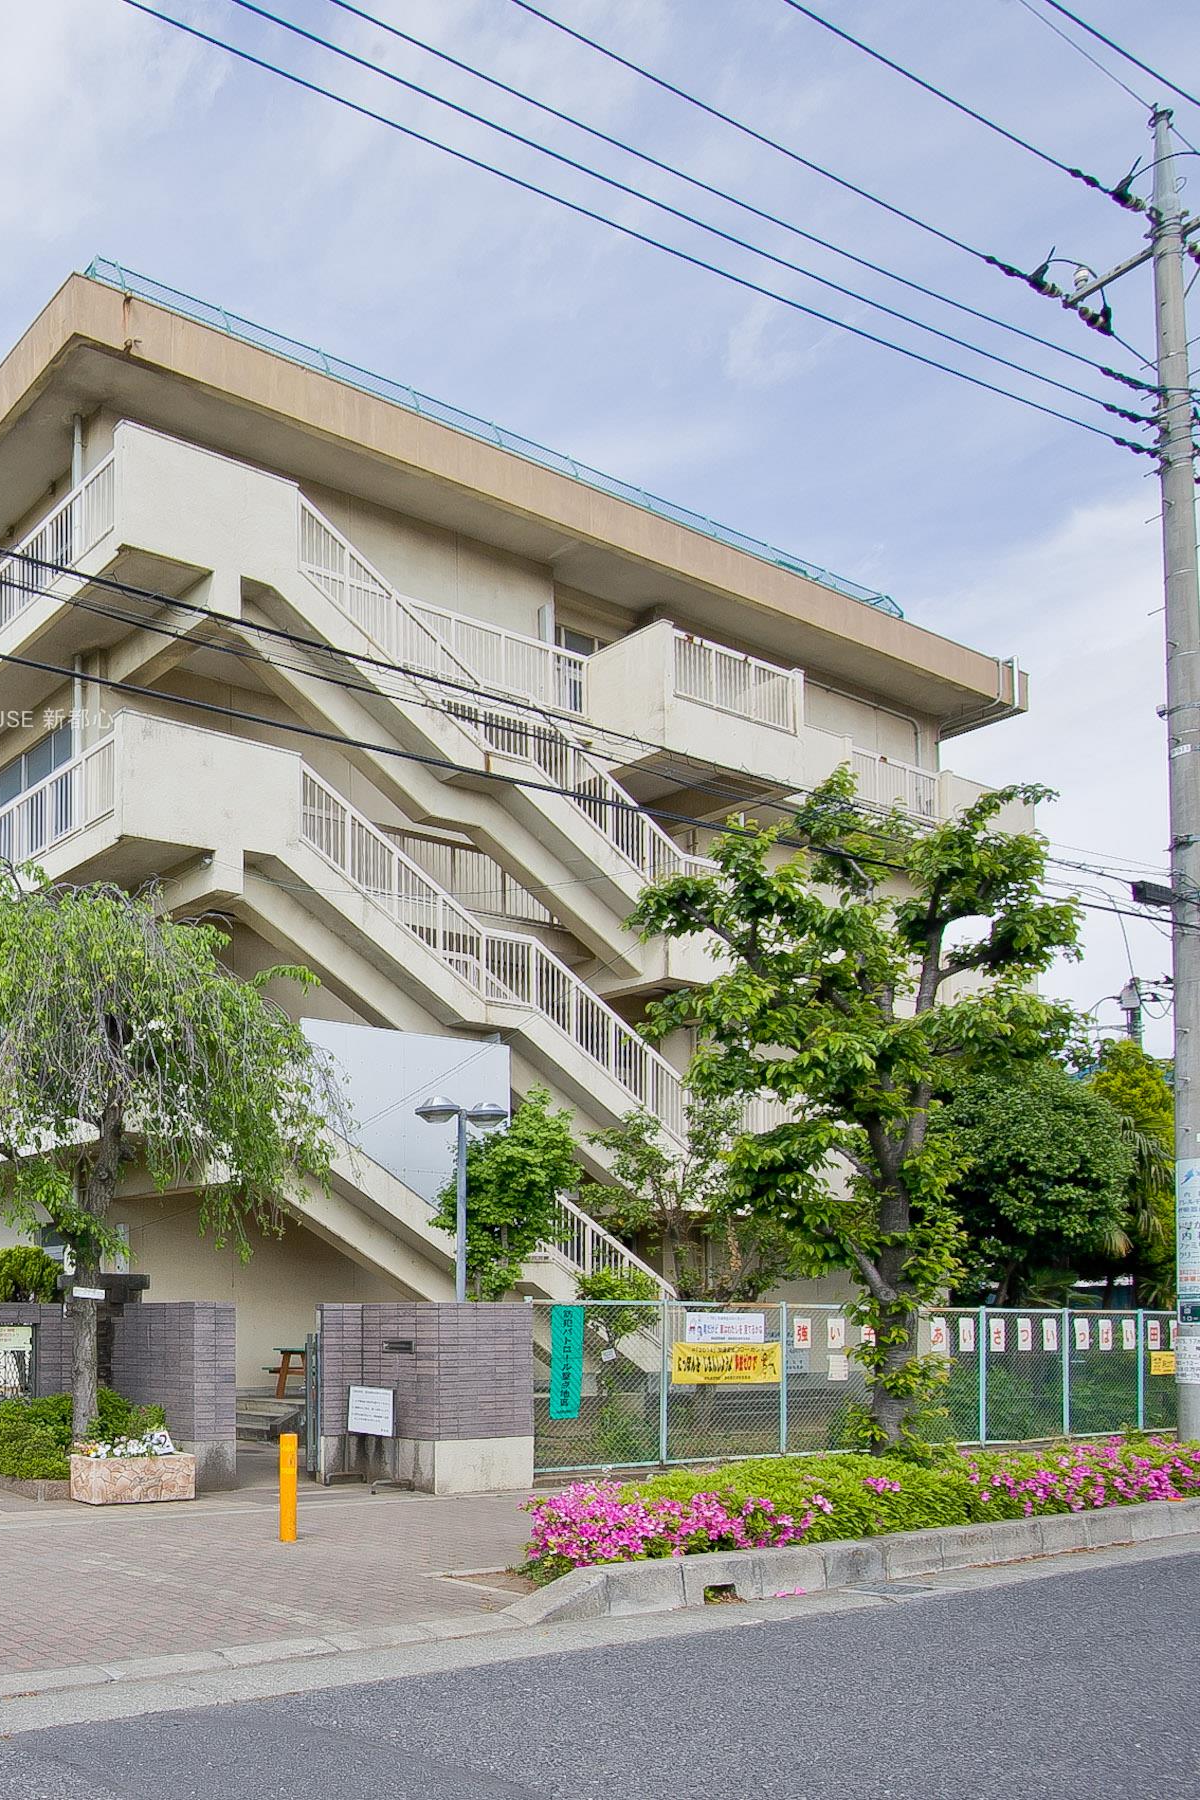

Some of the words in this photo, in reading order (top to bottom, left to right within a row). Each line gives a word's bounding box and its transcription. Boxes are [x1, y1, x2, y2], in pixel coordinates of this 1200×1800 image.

[559, 1309, 574, 1407] 防犯パトロール重点地区
